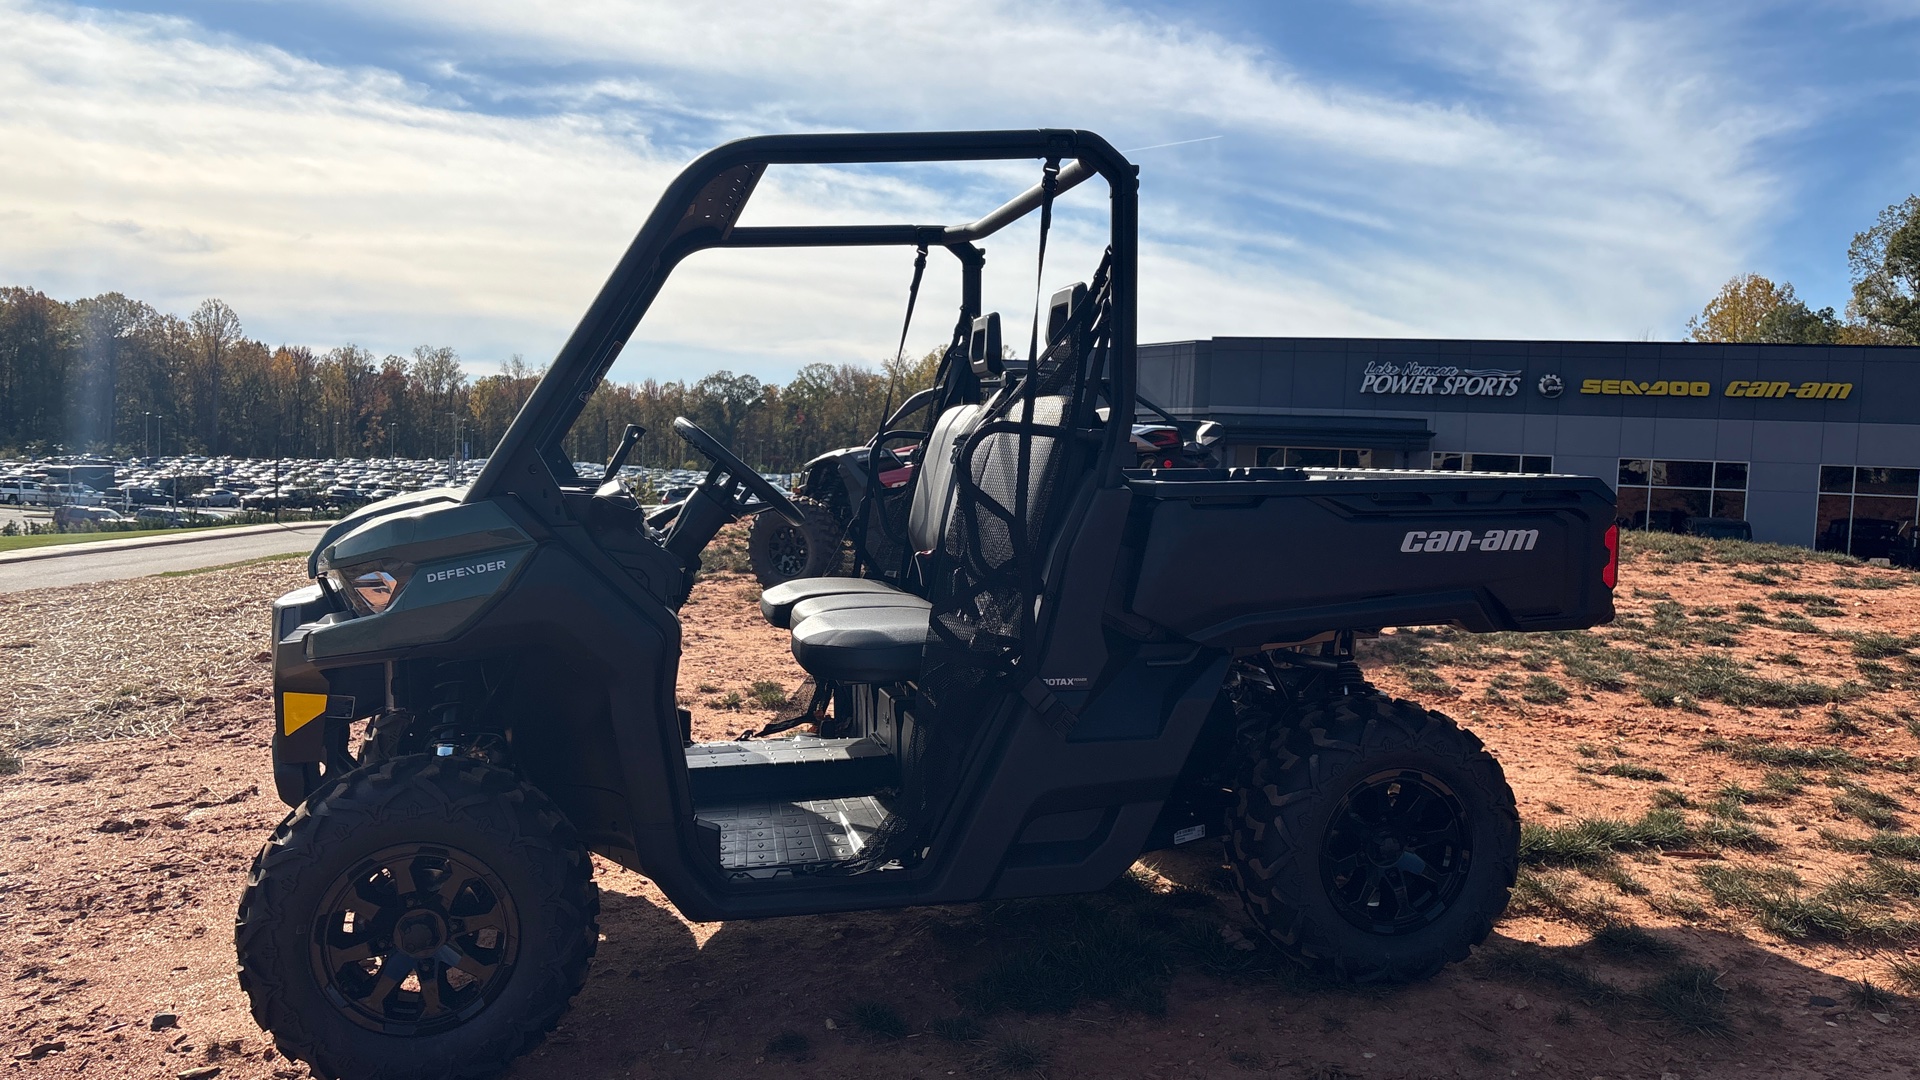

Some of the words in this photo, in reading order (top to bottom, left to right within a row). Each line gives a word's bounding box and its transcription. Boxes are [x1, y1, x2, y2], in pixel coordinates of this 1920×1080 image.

[1364, 361, 1400, 376] Lake
[1401, 362, 1459, 376] Norman
[1360, 375, 1436, 395] POWER
[1440, 375, 1521, 396] SPORTS
[1724, 380, 1853, 399] can-am
[1400, 529, 1539, 552] can-am
[427, 560, 506, 583] DEFENDER
